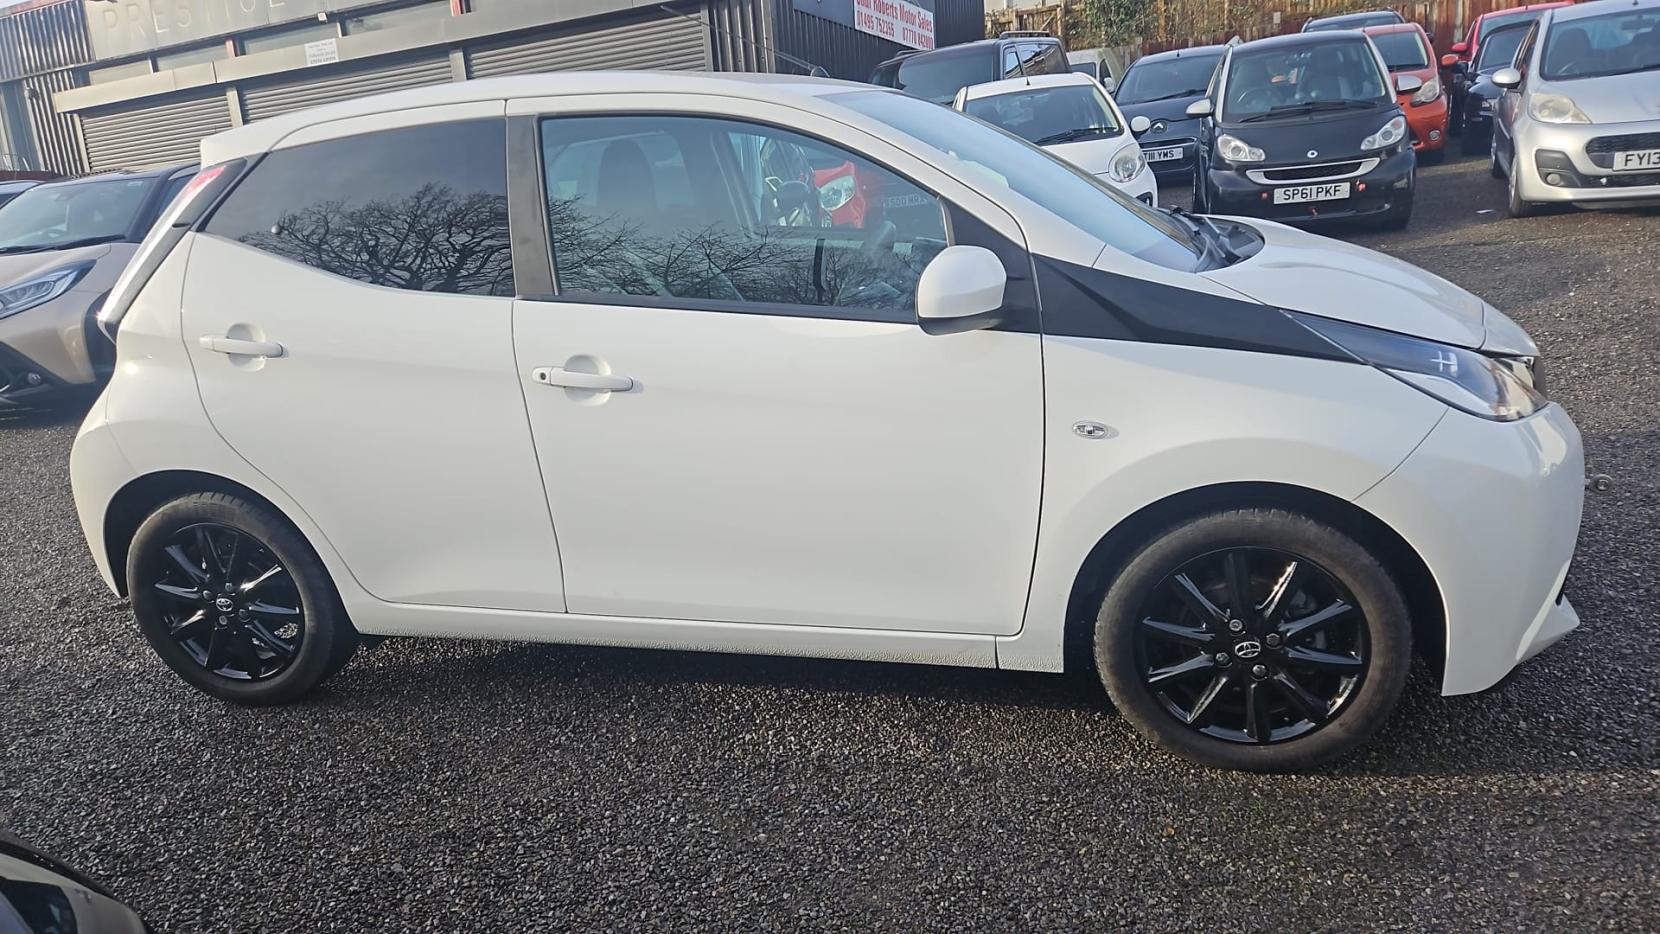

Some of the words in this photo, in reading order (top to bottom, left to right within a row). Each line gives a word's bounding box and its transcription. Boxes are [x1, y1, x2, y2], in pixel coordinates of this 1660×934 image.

[873, 0, 898, 20] Roberts
[899, 3, 917, 26] Motor
[918, 11, 932, 33] Sales
[1158, 150, 1174, 159] YMS
[1624, 152, 1660, 166] FY13
[1283, 187, 1312, 200] SP61
[1316, 185, 1341, 198] PKF
